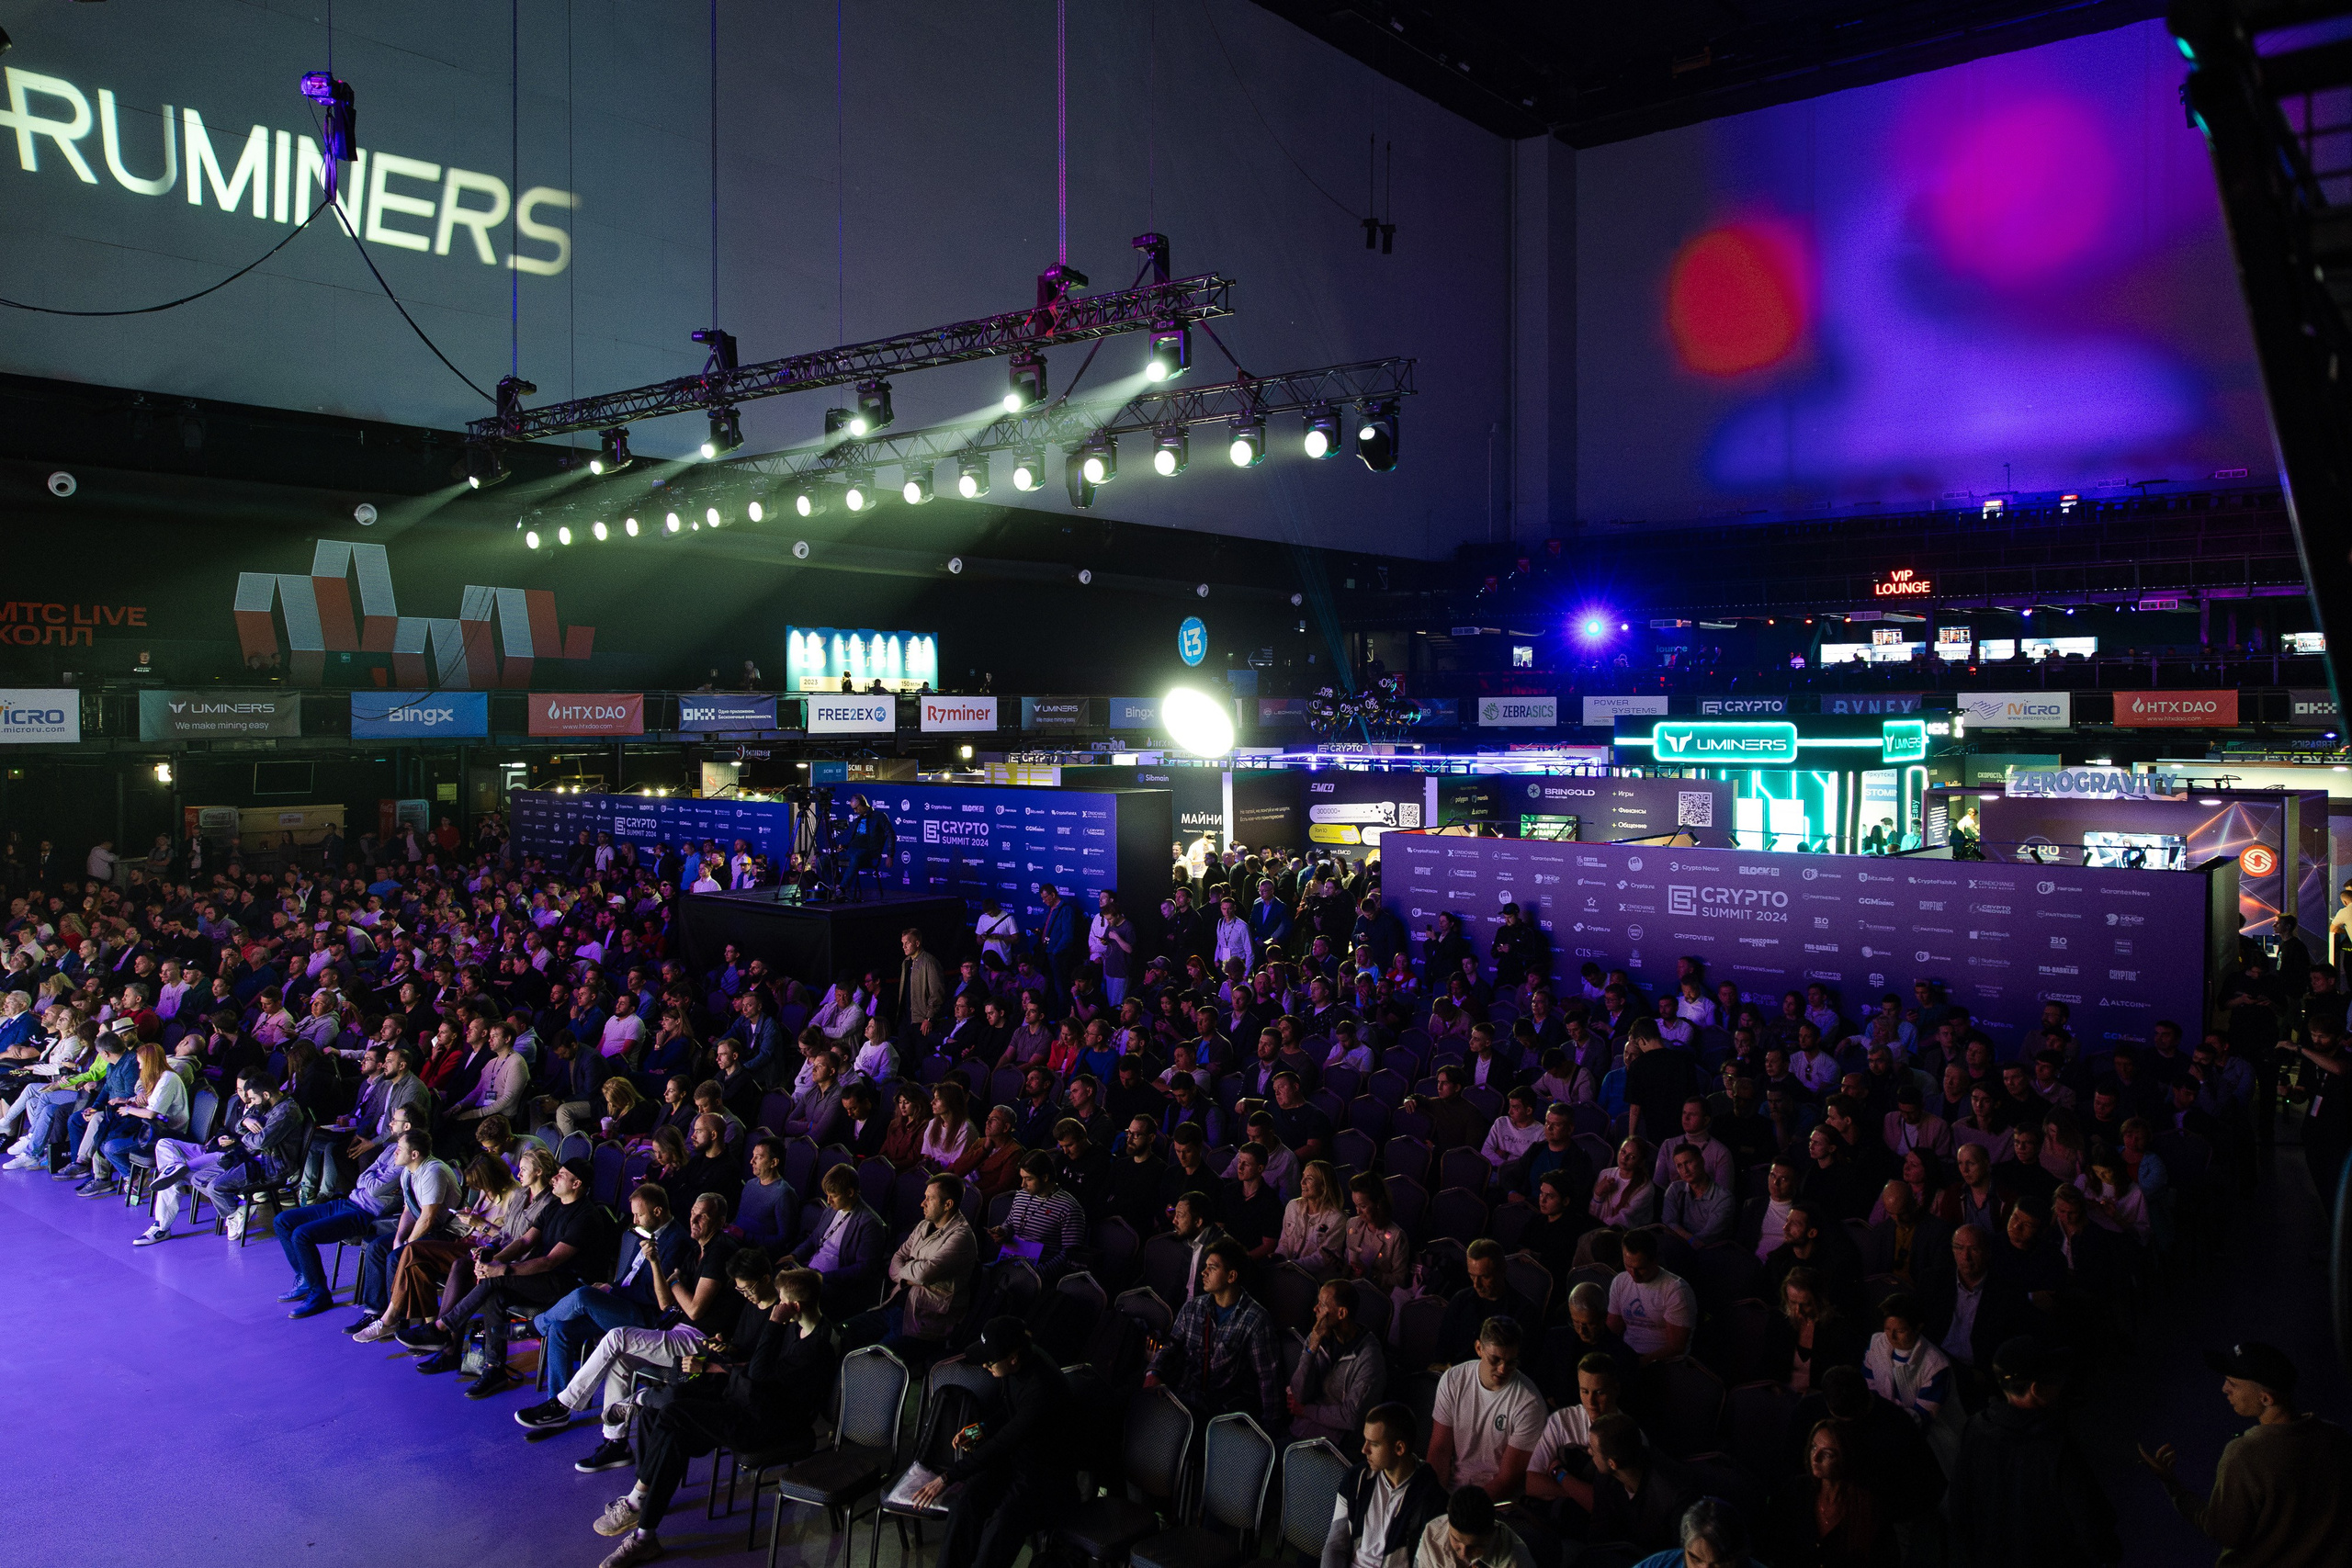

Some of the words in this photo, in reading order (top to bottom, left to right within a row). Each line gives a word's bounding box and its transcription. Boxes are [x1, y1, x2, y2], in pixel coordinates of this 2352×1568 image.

[1892, 570, 1914, 581] VIP
[1875, 581, 1931, 595] LOUNGE
[74, 605, 148, 626] LIVE
[191, 704, 275, 714] UMINERS
[1503, 705, 1554, 718] ZEBRASICS
[1724, 700, 1783, 712] CRYPTO
[2147, 702, 2179, 713] HTX
[2183, 701, 2217, 713] DAO
[2295, 703, 2337, 714] OKX
[562, 706, 592, 720] HTX
[595, 705, 626, 719] DAO
[683, 708, 716, 721] OKX
[818, 708, 874, 721] FREE2EX
[927, 705, 990, 724] R7miner
[175, 722, 190, 730] We
[191, 722, 216, 730] make
[218, 721, 247, 731] mining
[249, 722, 269, 731] easy
[562, 723, 613, 731] www.htxdao.com
[1330, 744, 1363, 752] CRYPTO
[1696, 739, 1787, 750] UMINERS
[1894, 736, 1921, 750] UMINERS
[848, 764, 874, 773] SCMIER
[1146, 773, 1170, 782] Sibmain
[2013, 771, 2178, 796] ZEROGRAVITY
[1544, 788, 1596, 796] BRINGOLD
[1618, 790, 1634, 798] Игры
[1912, 799, 1920, 819] Easy
[627, 818, 657, 829] CRYPTO
[1181, 811, 1222, 825] МАЙНИ
[942, 820, 989, 836] CRYPTO
[1618, 821, 1647, 829] Общение
[942, 837, 969, 846] SUMMIT
[971, 838, 989, 847] 2024
[1682, 864, 1702, 873] Crypto
[1701, 886, 1789, 908] CRYPTO
[2100, 887, 2151, 897] GarantexNews
[1919, 900, 1943, 911] CRYPTUS
[1702, 908, 1752, 920] SUMMIT
[1756, 910, 1789, 923] 2024
[1674, 933, 1714, 942] CRYPTOVIEW
[1576, 947, 1591, 958] CIS
[2109, 969, 2136, 981] CRYPTUS
[1752, 993, 1775, 1001] Crypto
[2110, 999, 2144, 1009] ALTCOIN
[1983, 1019, 2014, 1029] Crypto.ru
